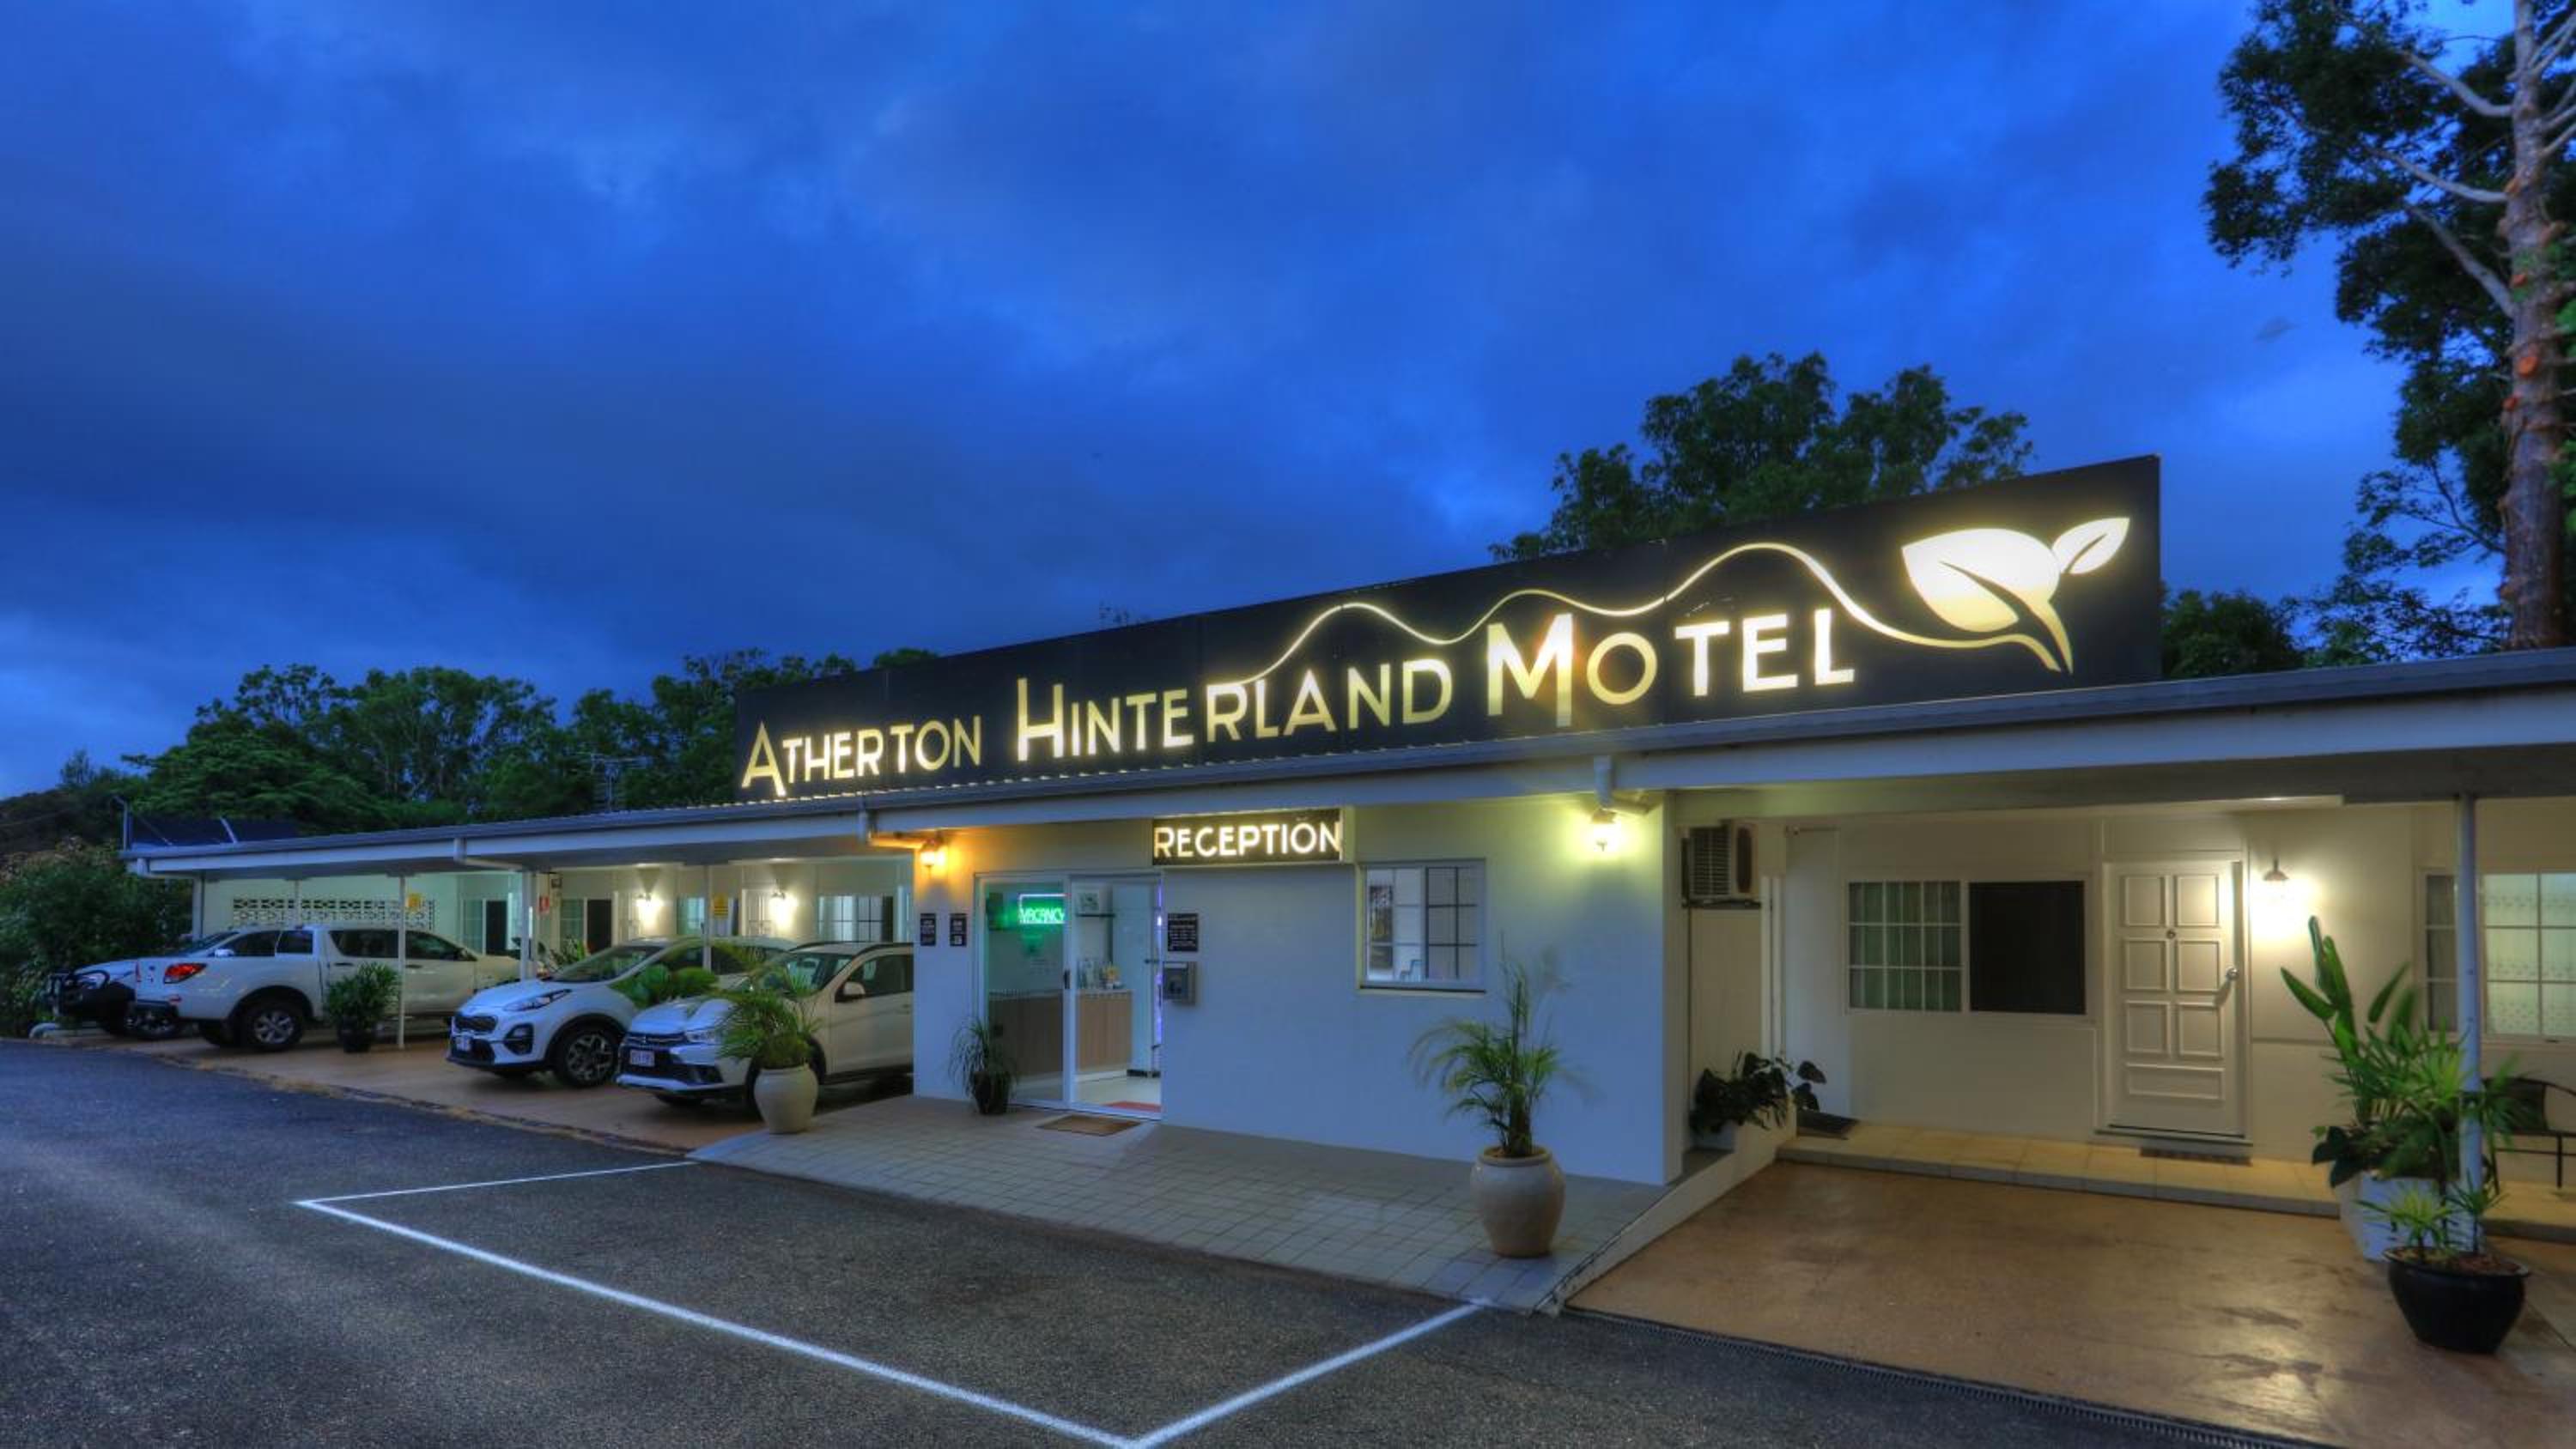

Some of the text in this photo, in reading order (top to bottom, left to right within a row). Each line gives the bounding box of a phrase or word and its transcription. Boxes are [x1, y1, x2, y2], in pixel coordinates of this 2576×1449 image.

[741, 605, 1856, 797] ATHERTON HINTERLAND MOTEL
[1153, 822, 1341, 858] RECEPTION
